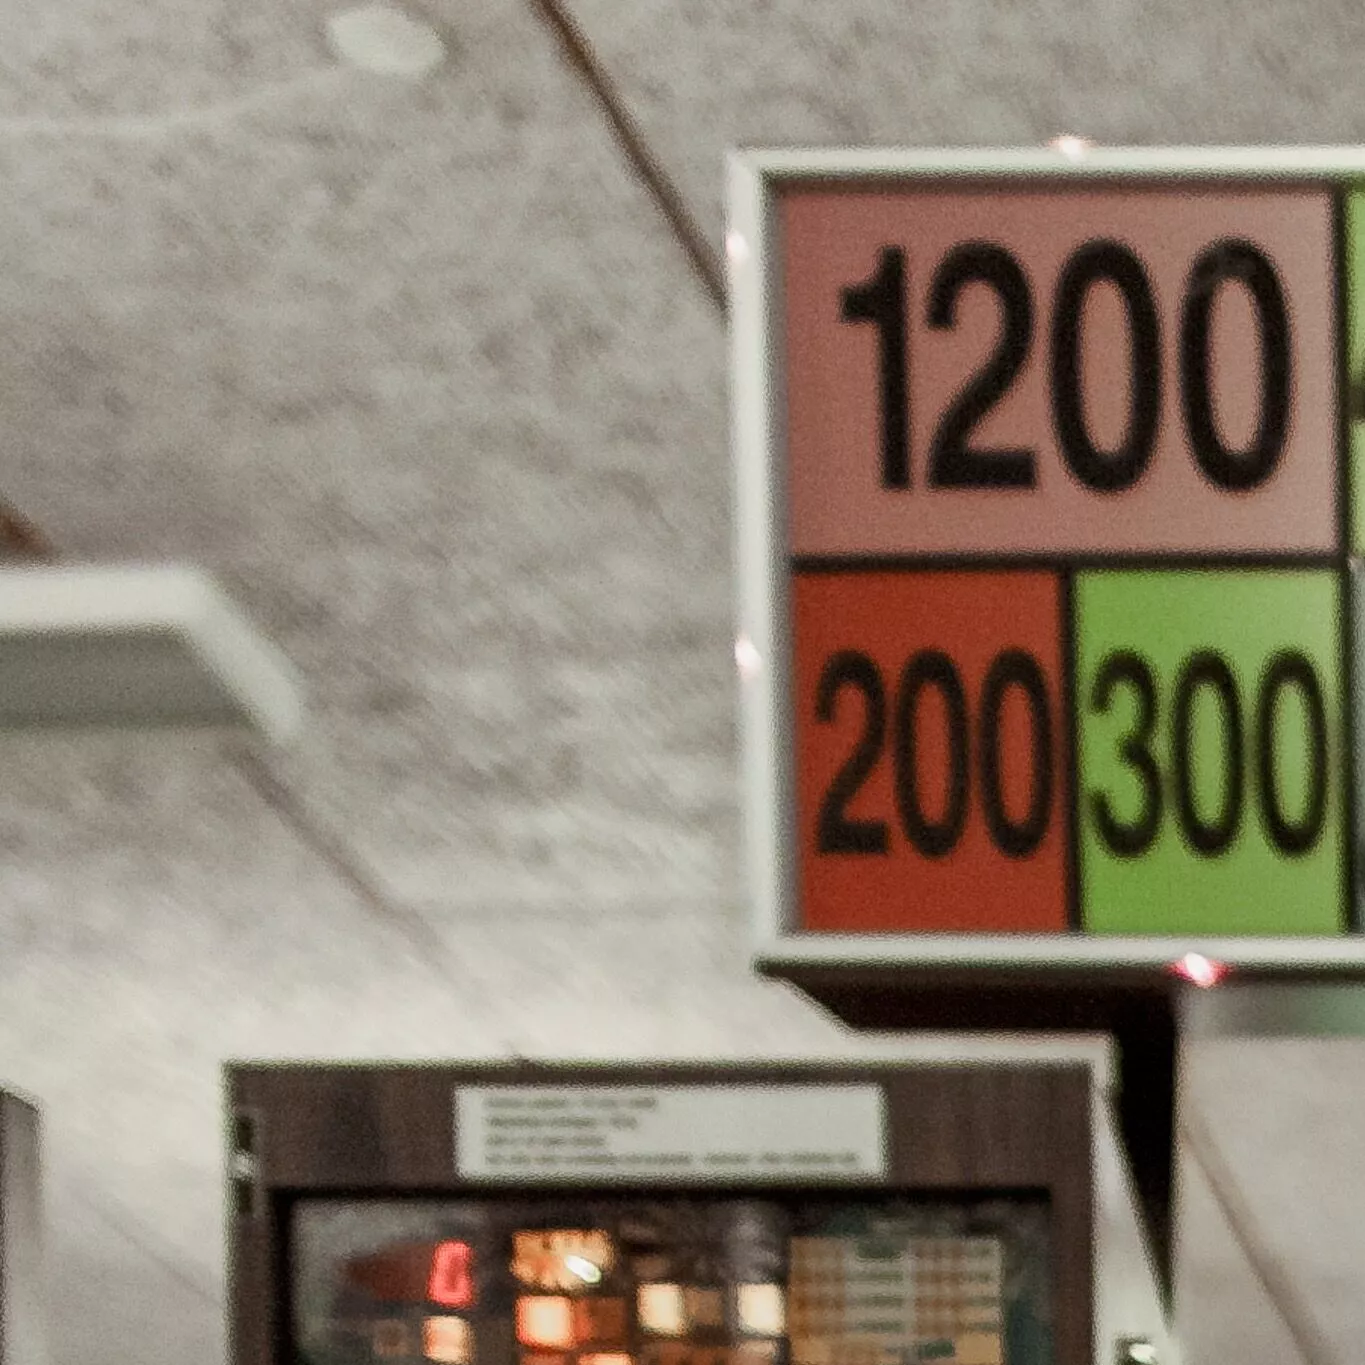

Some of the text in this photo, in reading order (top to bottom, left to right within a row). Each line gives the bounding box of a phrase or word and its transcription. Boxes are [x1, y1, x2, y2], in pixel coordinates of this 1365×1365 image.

[840, 239, 1292, 493] 1200
[814, 648, 1055, 859] 200
[1088, 648, 1330, 859] 300
